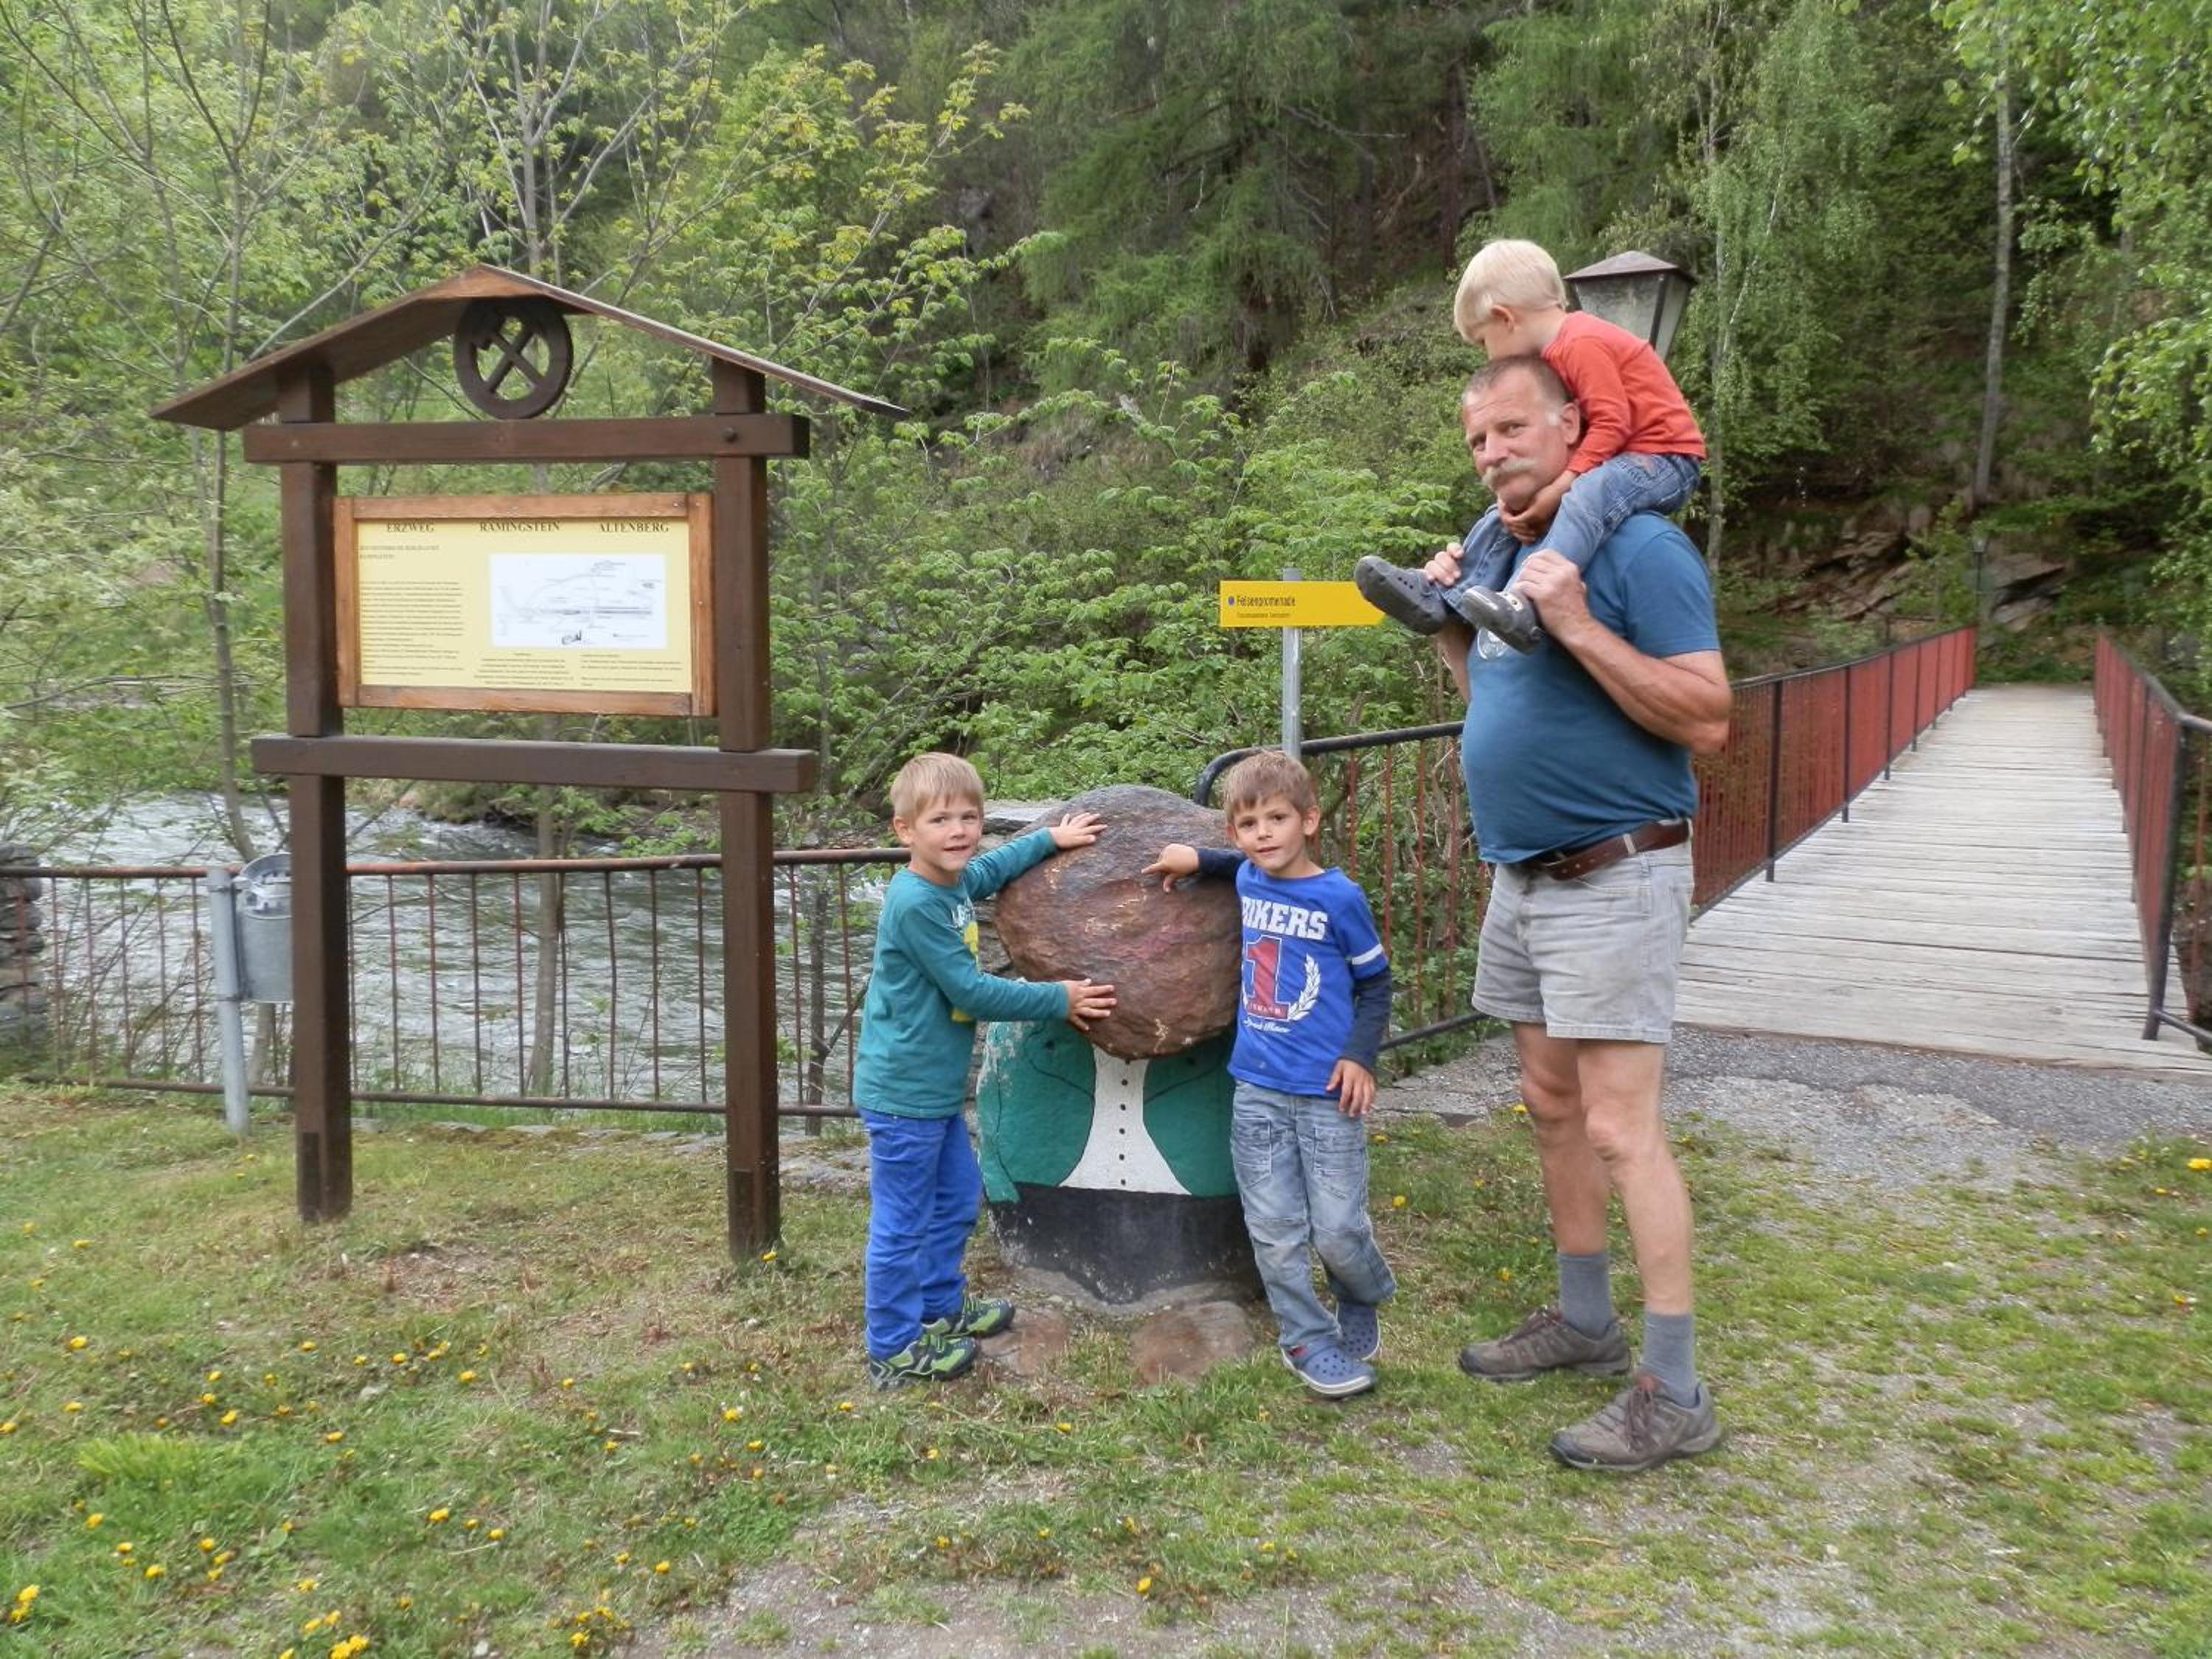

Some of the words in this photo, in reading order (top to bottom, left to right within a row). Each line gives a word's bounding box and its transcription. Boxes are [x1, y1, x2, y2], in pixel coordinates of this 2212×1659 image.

[386, 521, 434, 532] ERZWEG
[479, 521, 560, 532] RAMINGSTEIN
[599, 522, 669, 532] ALTENBERG
[1245, 934, 1290, 1022] 1
